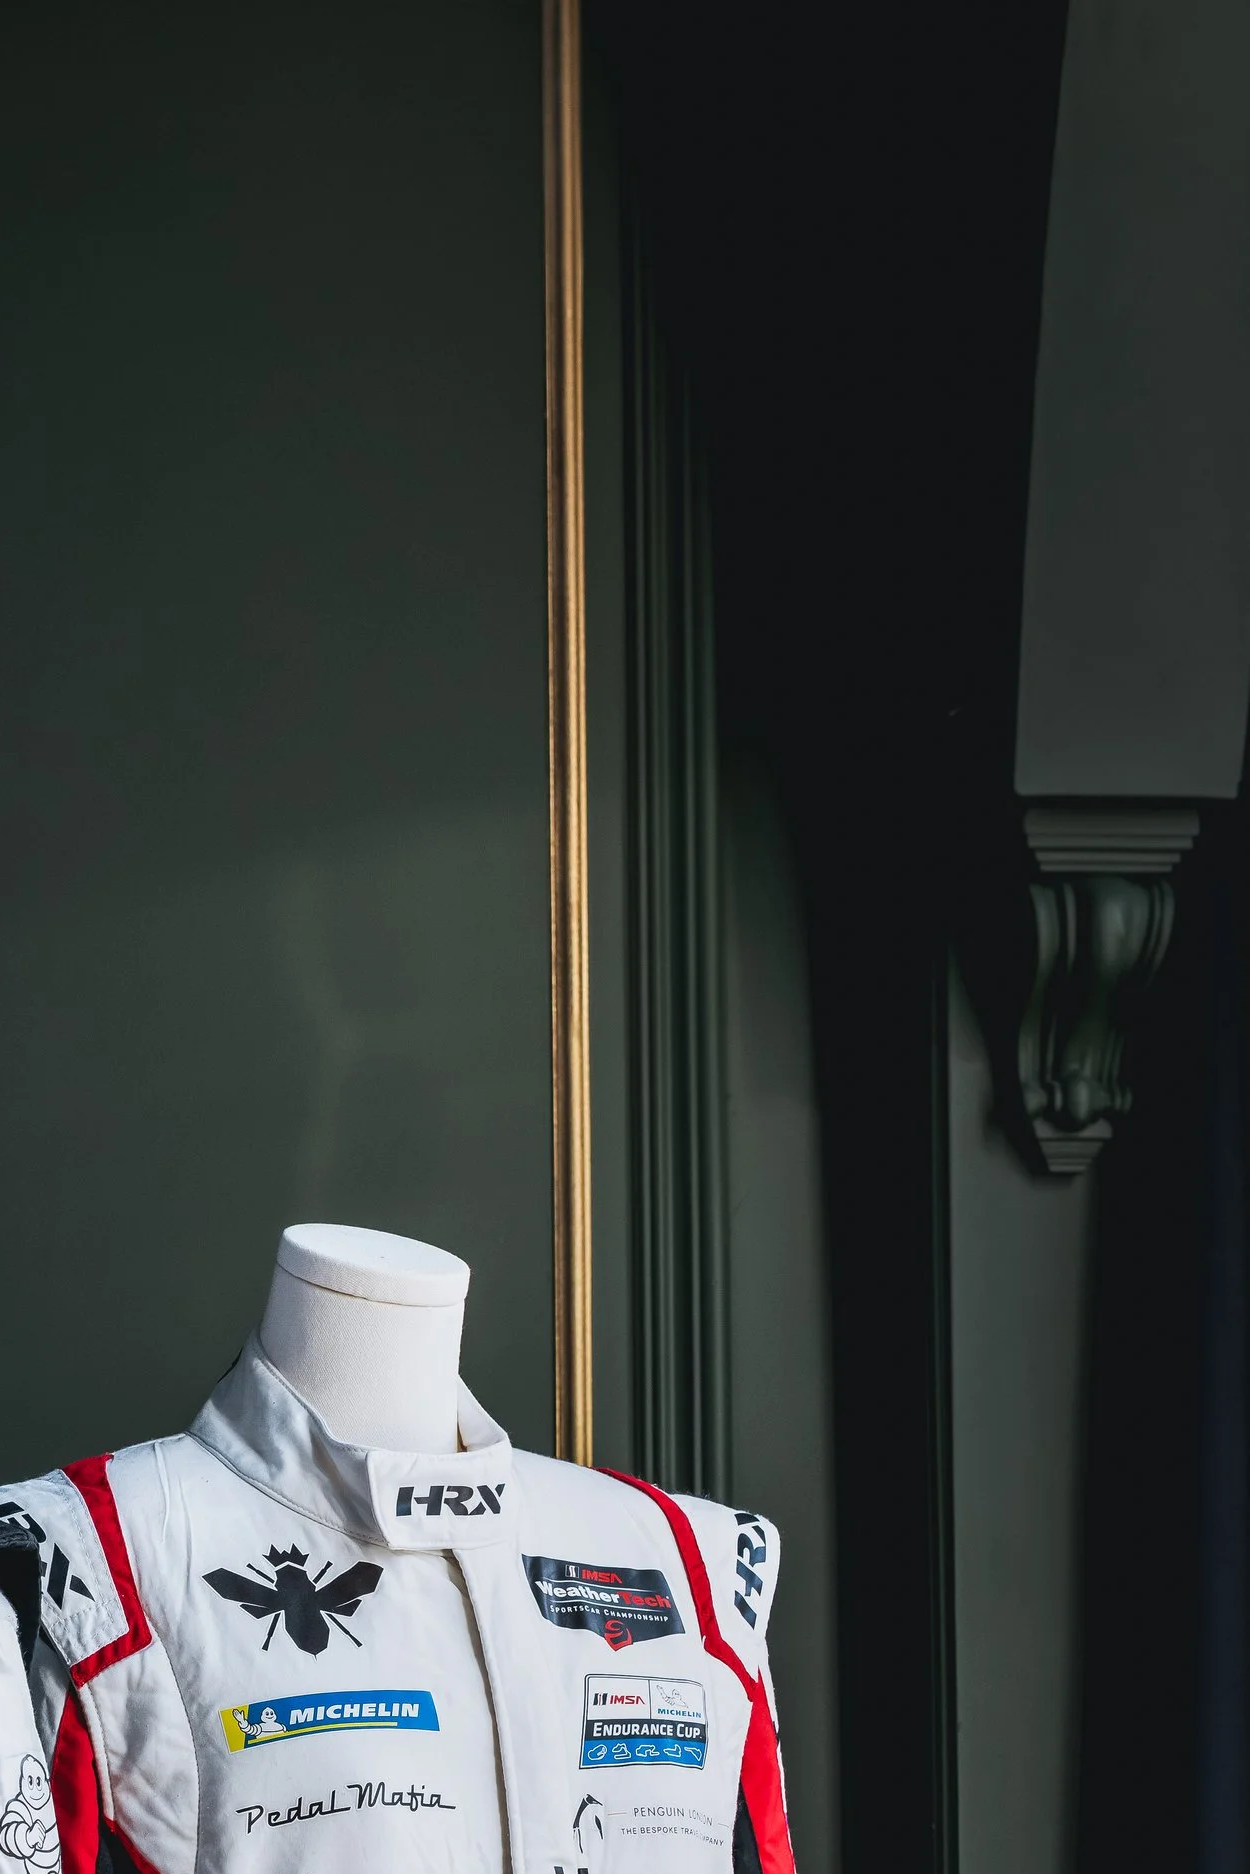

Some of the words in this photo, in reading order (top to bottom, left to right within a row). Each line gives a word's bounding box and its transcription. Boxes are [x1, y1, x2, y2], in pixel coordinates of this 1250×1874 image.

[396, 1483, 505, 1516] HRX
[582, 1569, 622, 1584] IMSA
[289, 1702, 420, 1725] MICHELIN
[657, 1708, 702, 1719] MICHELIN
[593, 1722, 674, 1738] ENDURANCE
[236, 1790, 351, 1834] Pedal
[347, 1781, 456, 1812] Mafia
[633, 1806, 685, 1817] PENGUIN
[688, 1808, 713, 1827] LONON
[621, 1827, 637, 1835] THE
[640, 1826, 678, 1835] BESPOKE
